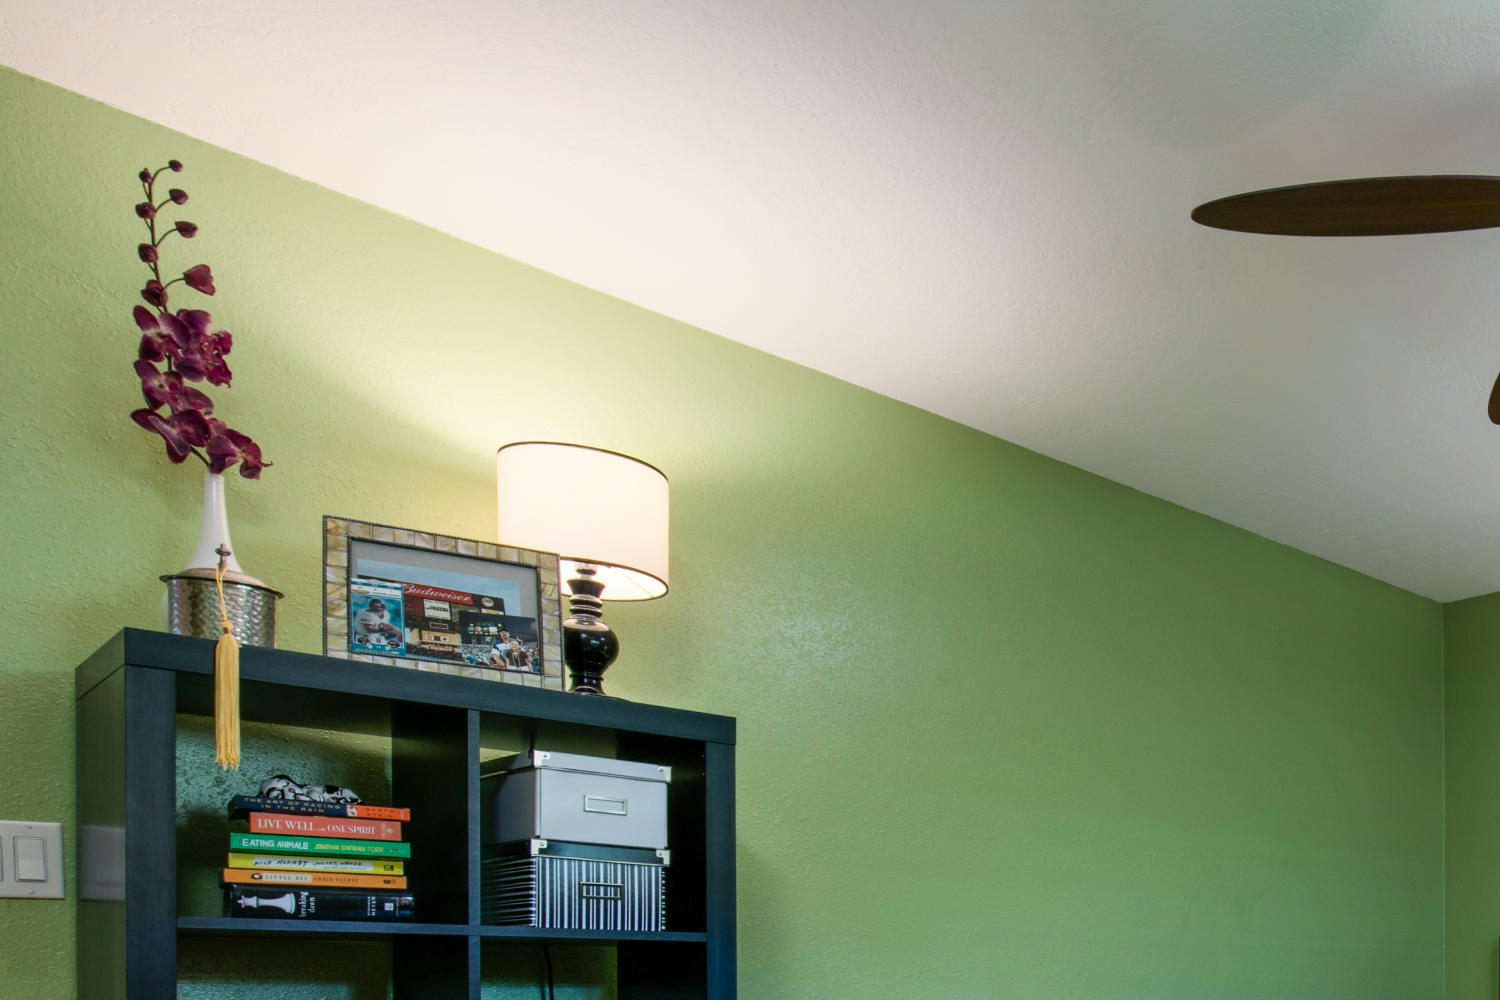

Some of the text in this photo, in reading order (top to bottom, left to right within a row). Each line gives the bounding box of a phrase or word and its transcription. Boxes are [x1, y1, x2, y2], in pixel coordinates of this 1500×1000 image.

[402, 583, 471, 603] Budweiser
[257, 818, 284, 830] LIVE
[285, 820, 315, 832] WELL
[327, 824, 347, 834] ONE
[348, 825, 377, 836] SPIRIT
[242, 838, 276, 848] EATING
[277, 840, 310, 850] ANIMALS
[298, 891, 309, 918] breaking
[308, 896, 316, 914] dawn
